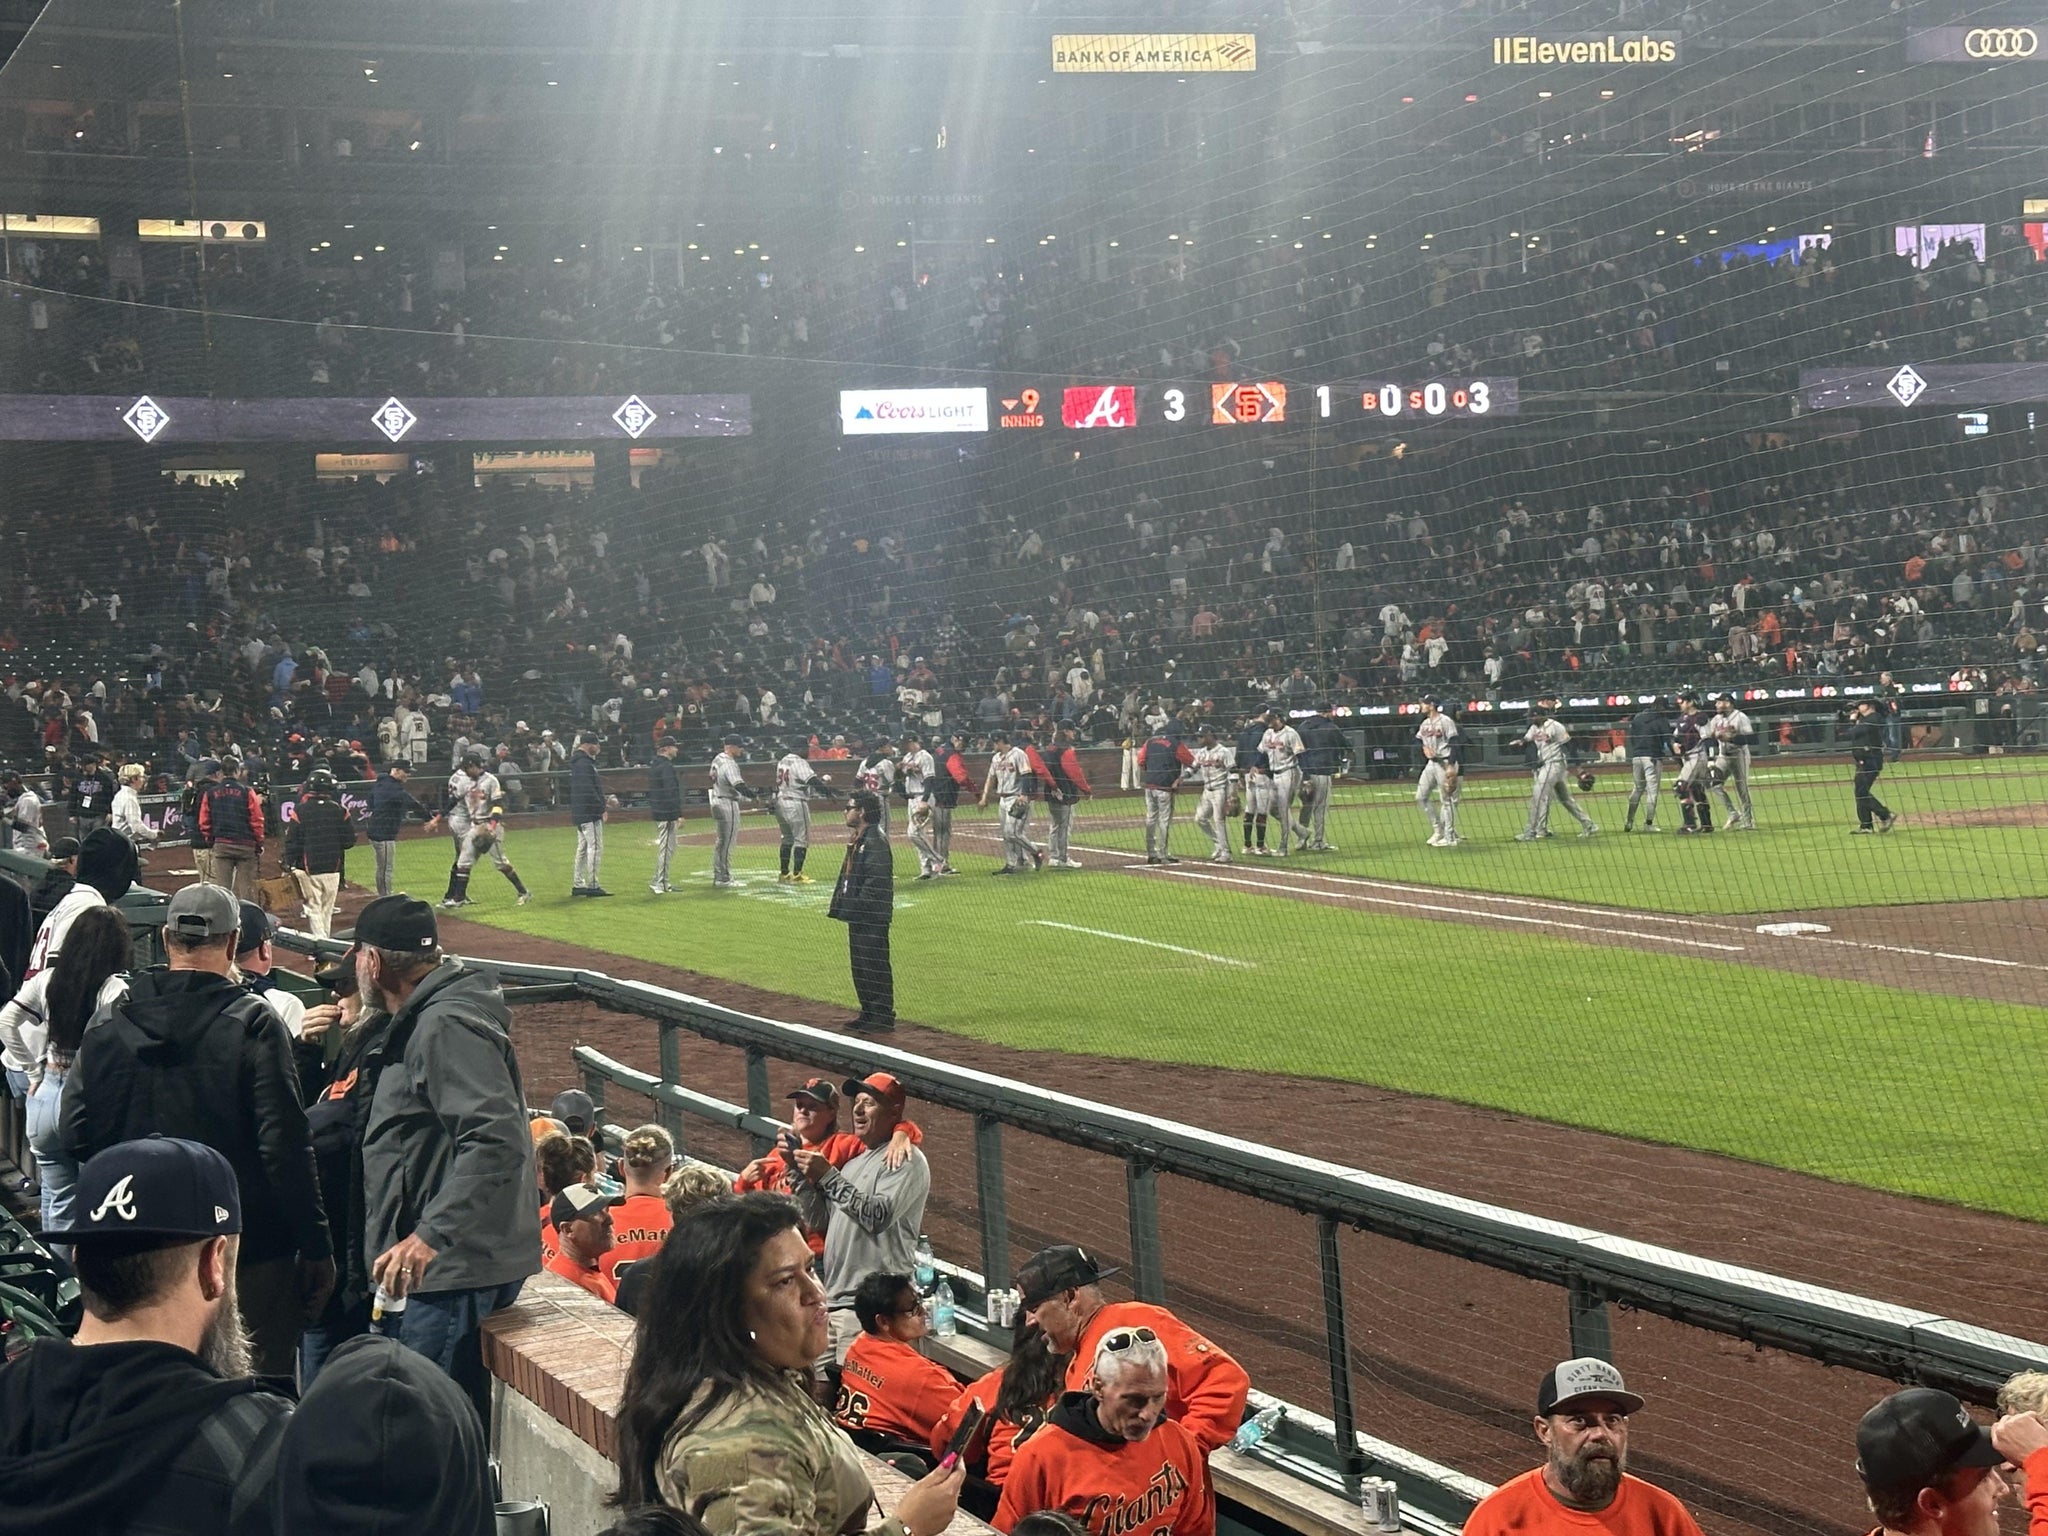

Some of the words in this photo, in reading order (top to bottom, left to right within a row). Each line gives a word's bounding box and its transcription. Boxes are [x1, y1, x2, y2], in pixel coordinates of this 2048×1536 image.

[1056, 50, 1104, 63] BANK
[1109, 50, 1130, 63] OF
[1134, 49, 1213, 63] AMERICA
[876, 401, 925, 420] Coors
[928, 404, 975, 419] LIGHT
[1021, 388, 1040, 414] 9
[1163, 388, 1186, 422] 3
[1316, 385, 1331, 418] 1
[1362, 392, 1377, 410] B
[1379, 383, 1401, 417] 0
[1409, 391, 1423, 409] S
[1424, 382, 1446, 416] 0
[1468, 381, 1490, 414] 3
[1001, 414, 1044, 428] INNING
[291, 759, 300, 771] 2
[90, 1174, 137, 1222] A
[843, 1359, 886, 1391] eMattei
[1566, 1363, 1591, 1383] DIRTY
[1079, 1459, 1188, 1536] Giants
